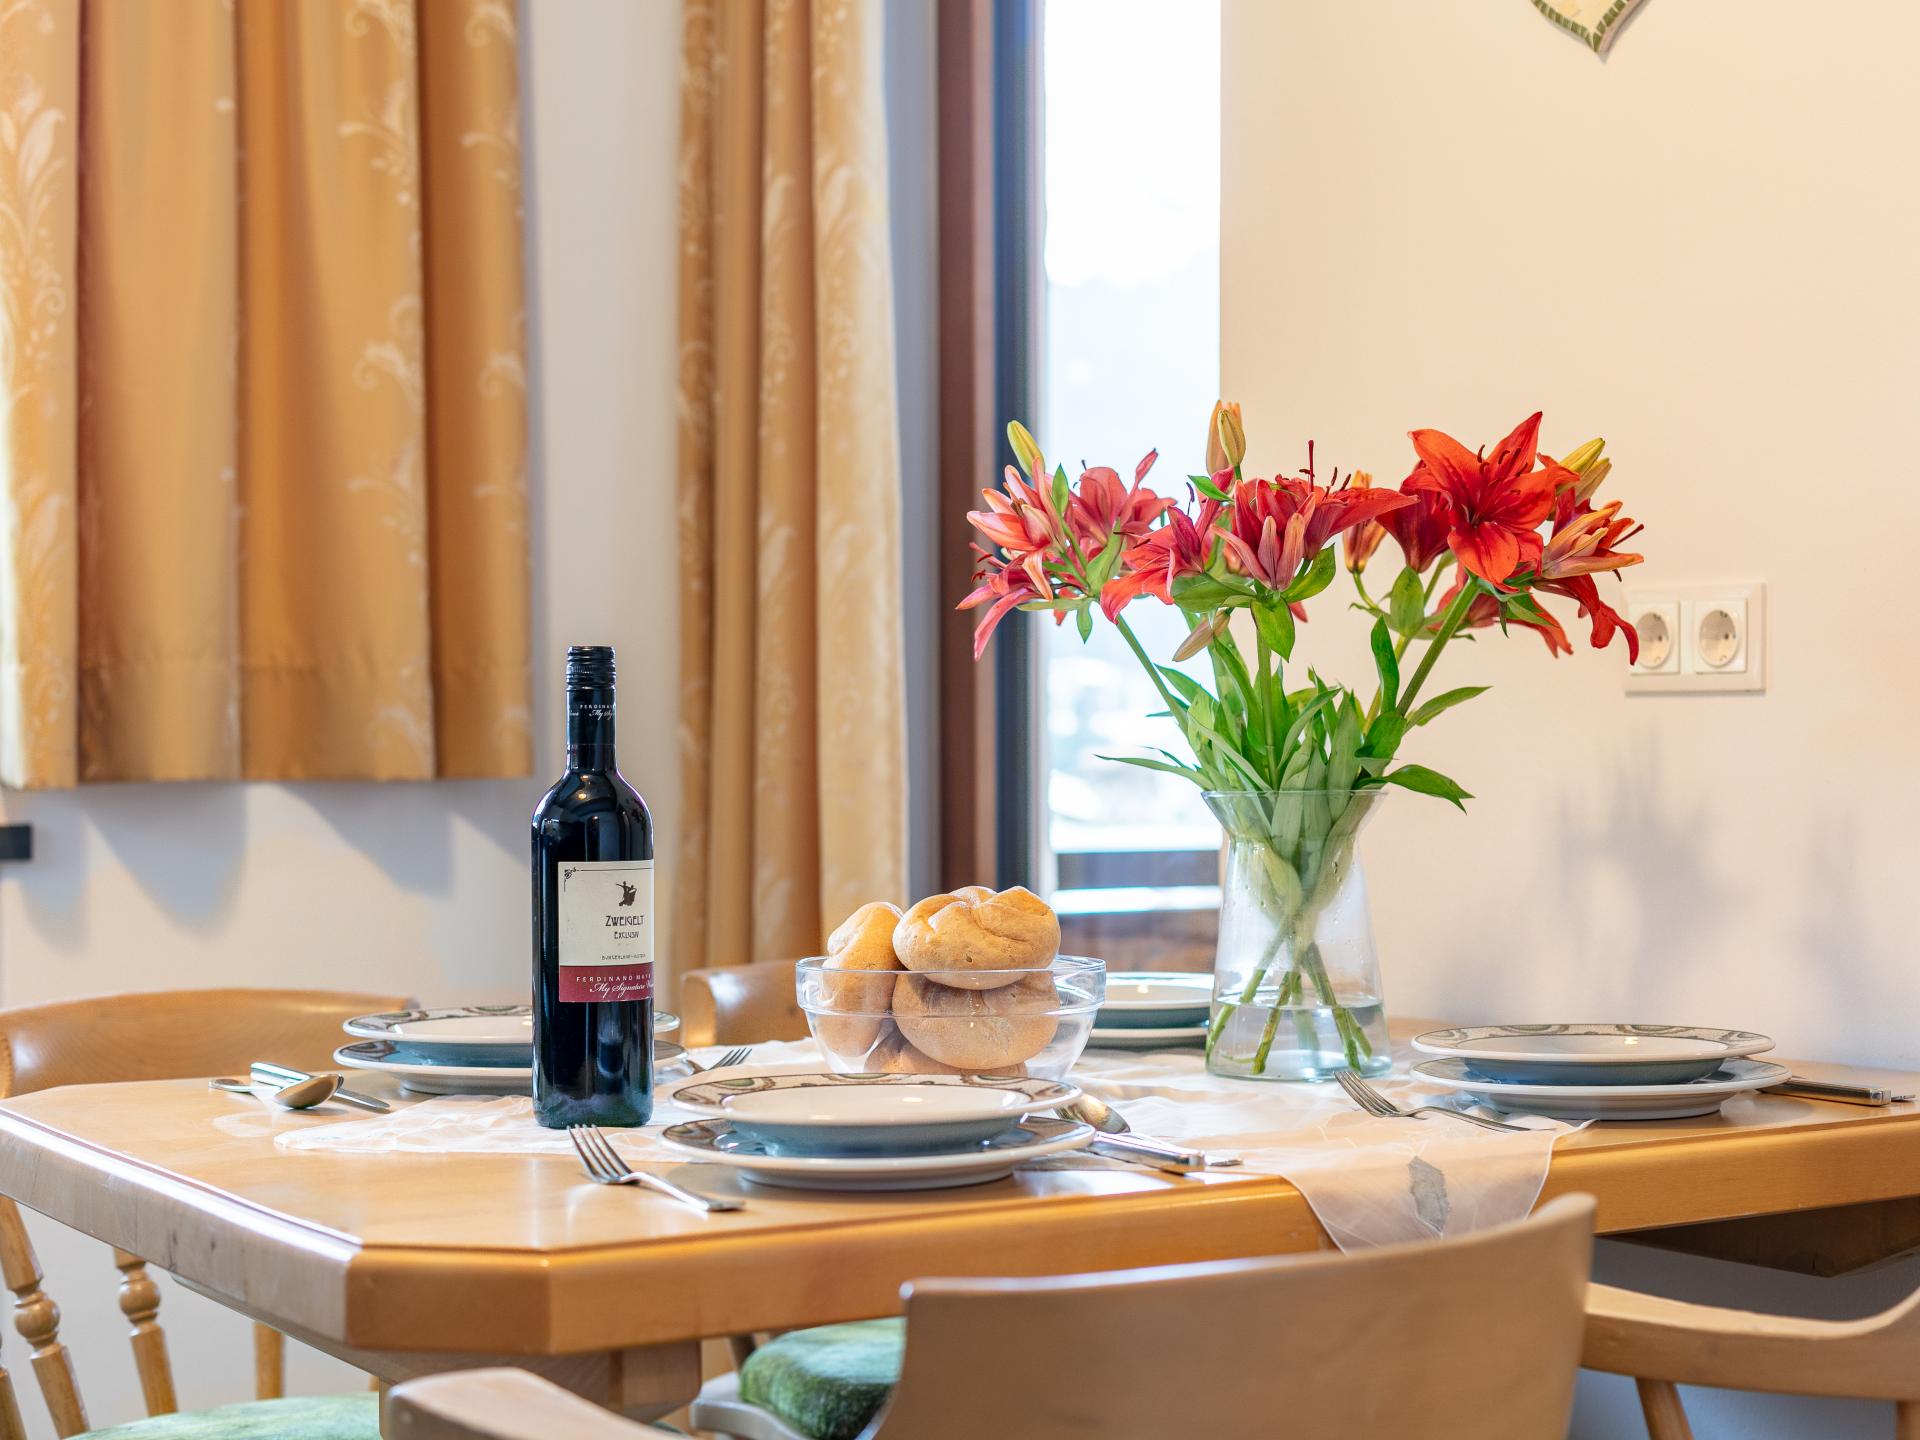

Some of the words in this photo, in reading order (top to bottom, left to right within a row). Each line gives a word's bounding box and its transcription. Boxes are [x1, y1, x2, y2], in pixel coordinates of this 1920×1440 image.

[605, 915, 644, 927] ZWEIGELT
[613, 931, 640, 940] EXCLUSIV
[576, 975, 633, 983] FERDINAND
[589, 982, 611, 999] My
[611, 981, 646, 999] Signature
